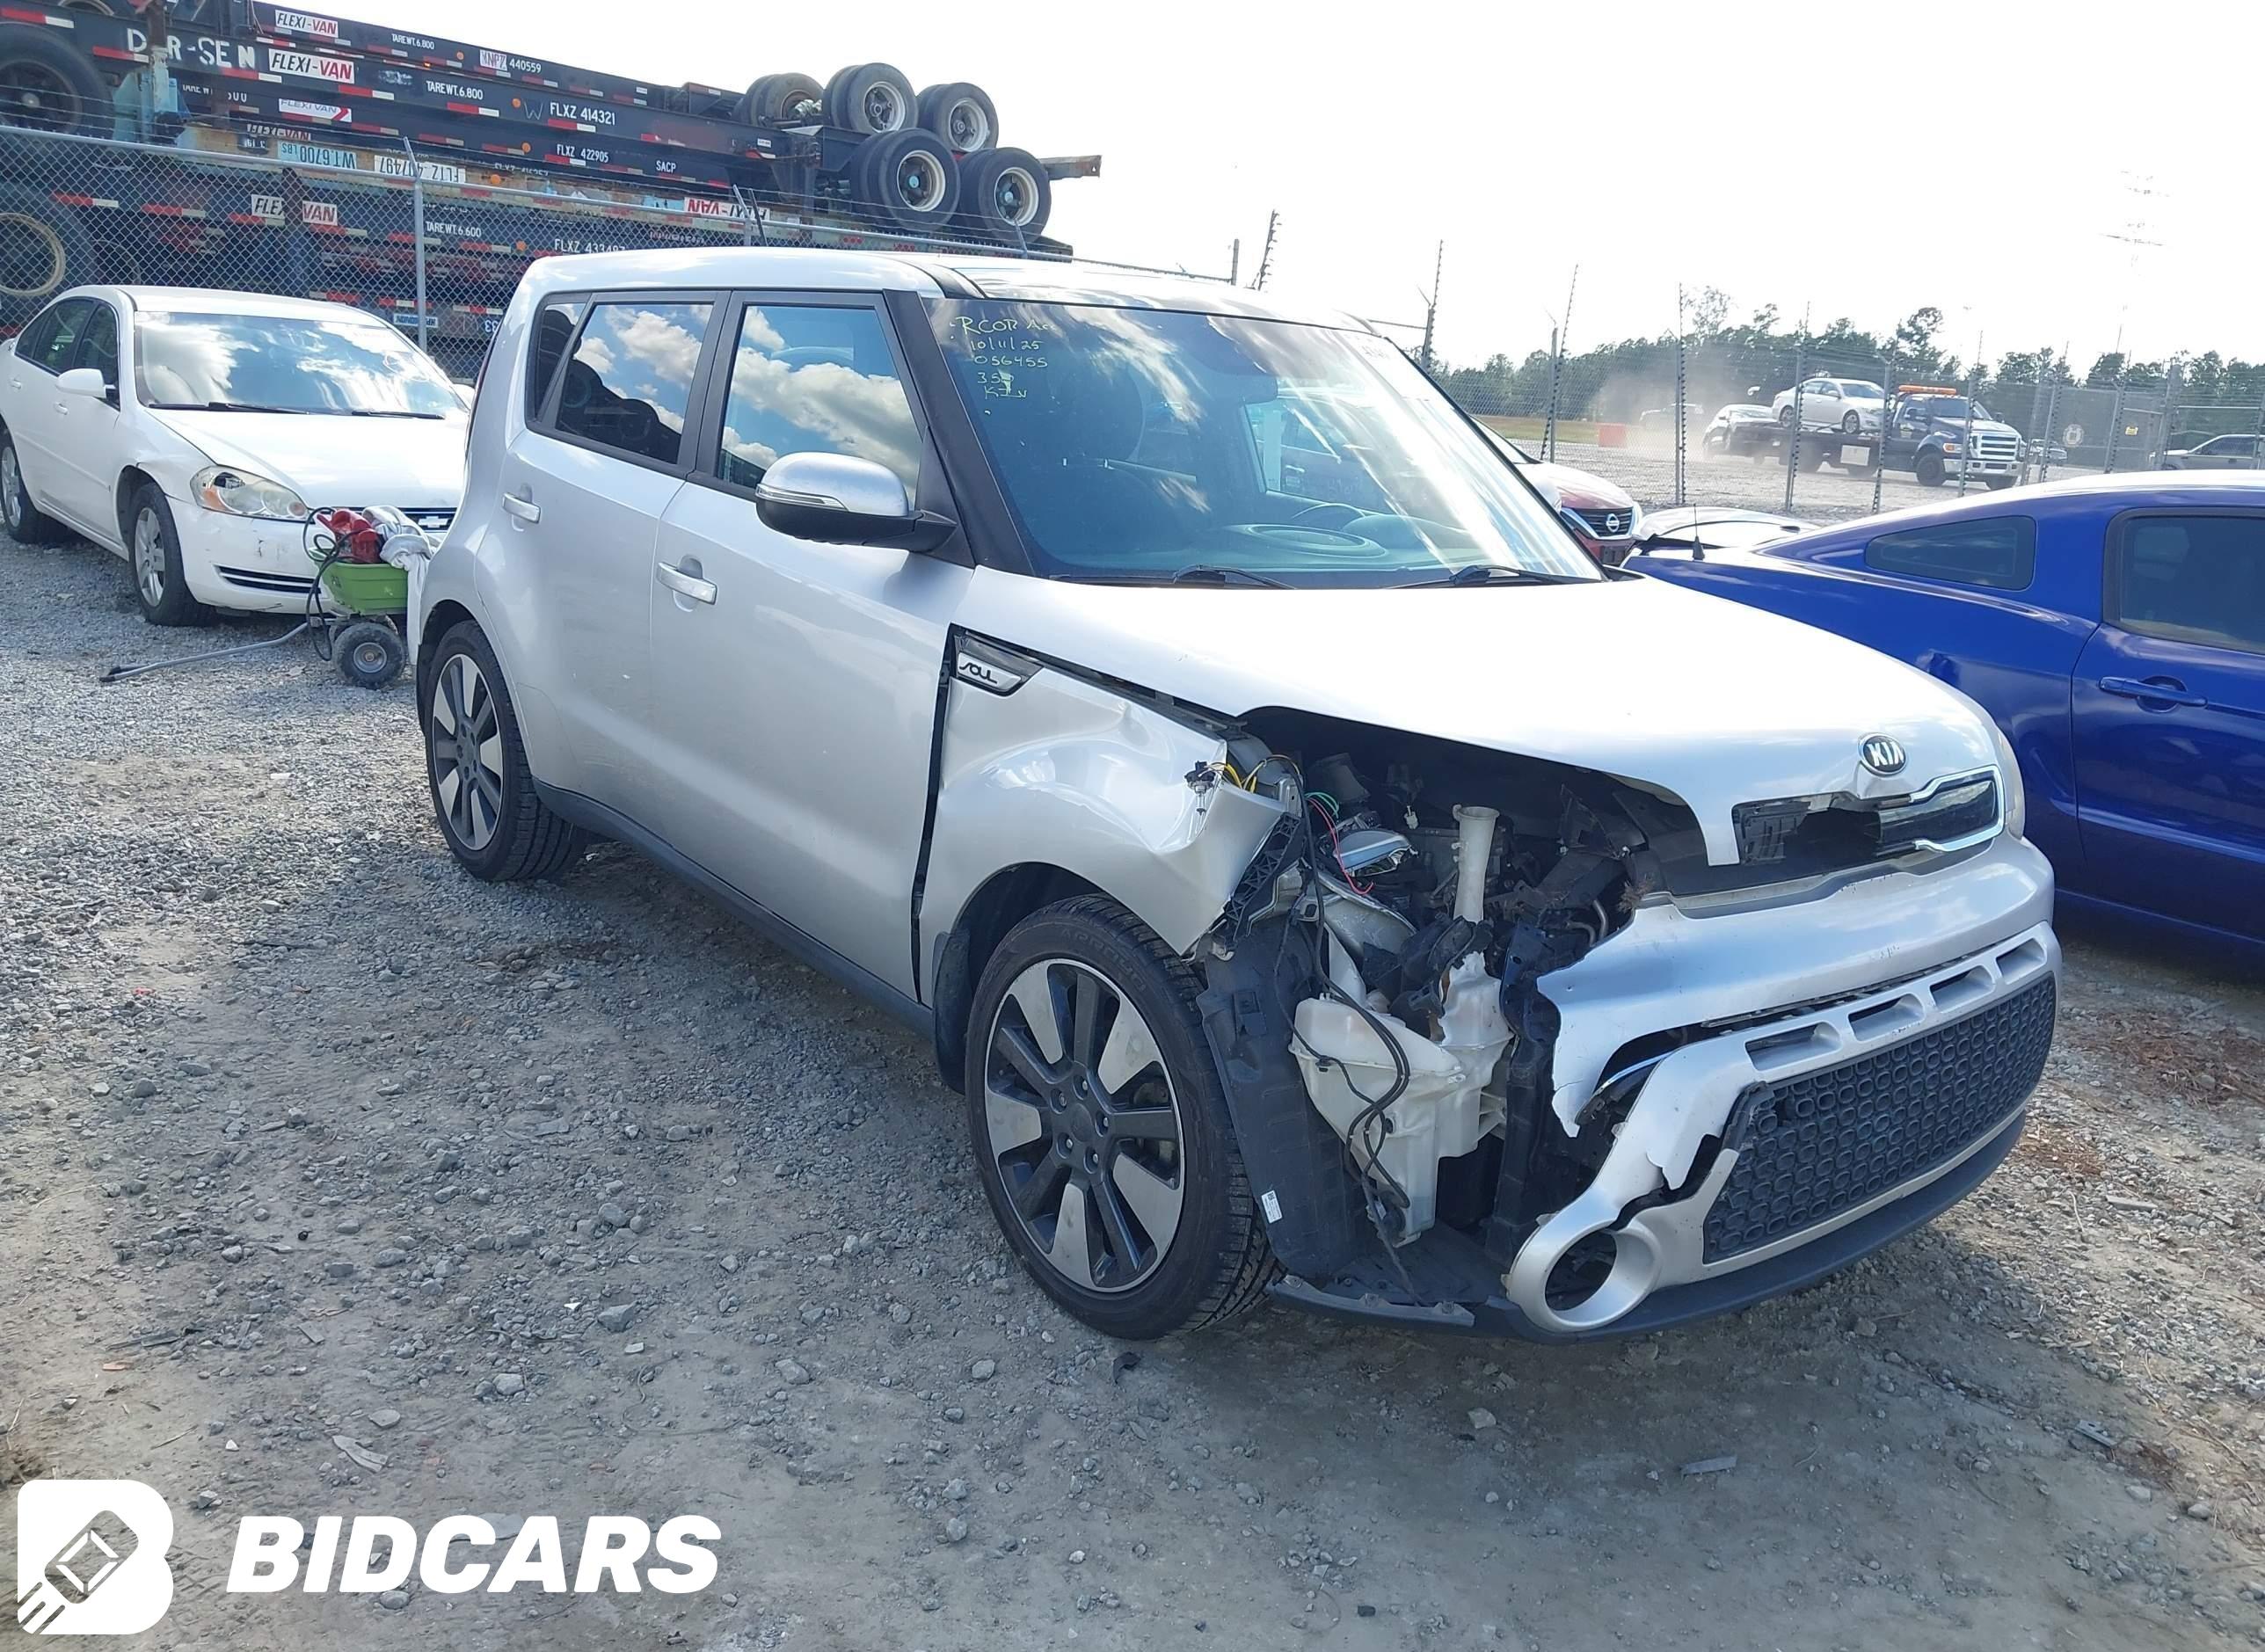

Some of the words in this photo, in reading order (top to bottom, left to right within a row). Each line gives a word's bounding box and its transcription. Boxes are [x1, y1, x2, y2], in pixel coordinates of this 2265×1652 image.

[277, 12, 337, 34] FLEXI-VAN
[127, 28, 255, 69] DR-SEN
[272, 54, 352, 80] FLEXI-VAN
[509, 58, 542, 73] 440559
[280, 98, 313, 111] FLEXI
[314, 104, 339, 114] VAN
[550, 101, 577, 120] FLXZ
[580, 107, 615, 126] 414321
[281, 142, 298, 156] LBS
[557, 143, 576, 157] FLXZ
[580, 148, 609, 164] 422905
[380, 156, 423, 178] 47497
[656, 159, 676, 174] SACP
[555, 238, 581, 253] FLXZ
[973, 355, 1049, 368] 056455
[958, 662, 998, 685] SOUL
[1866, 740, 1905, 768] KIA
